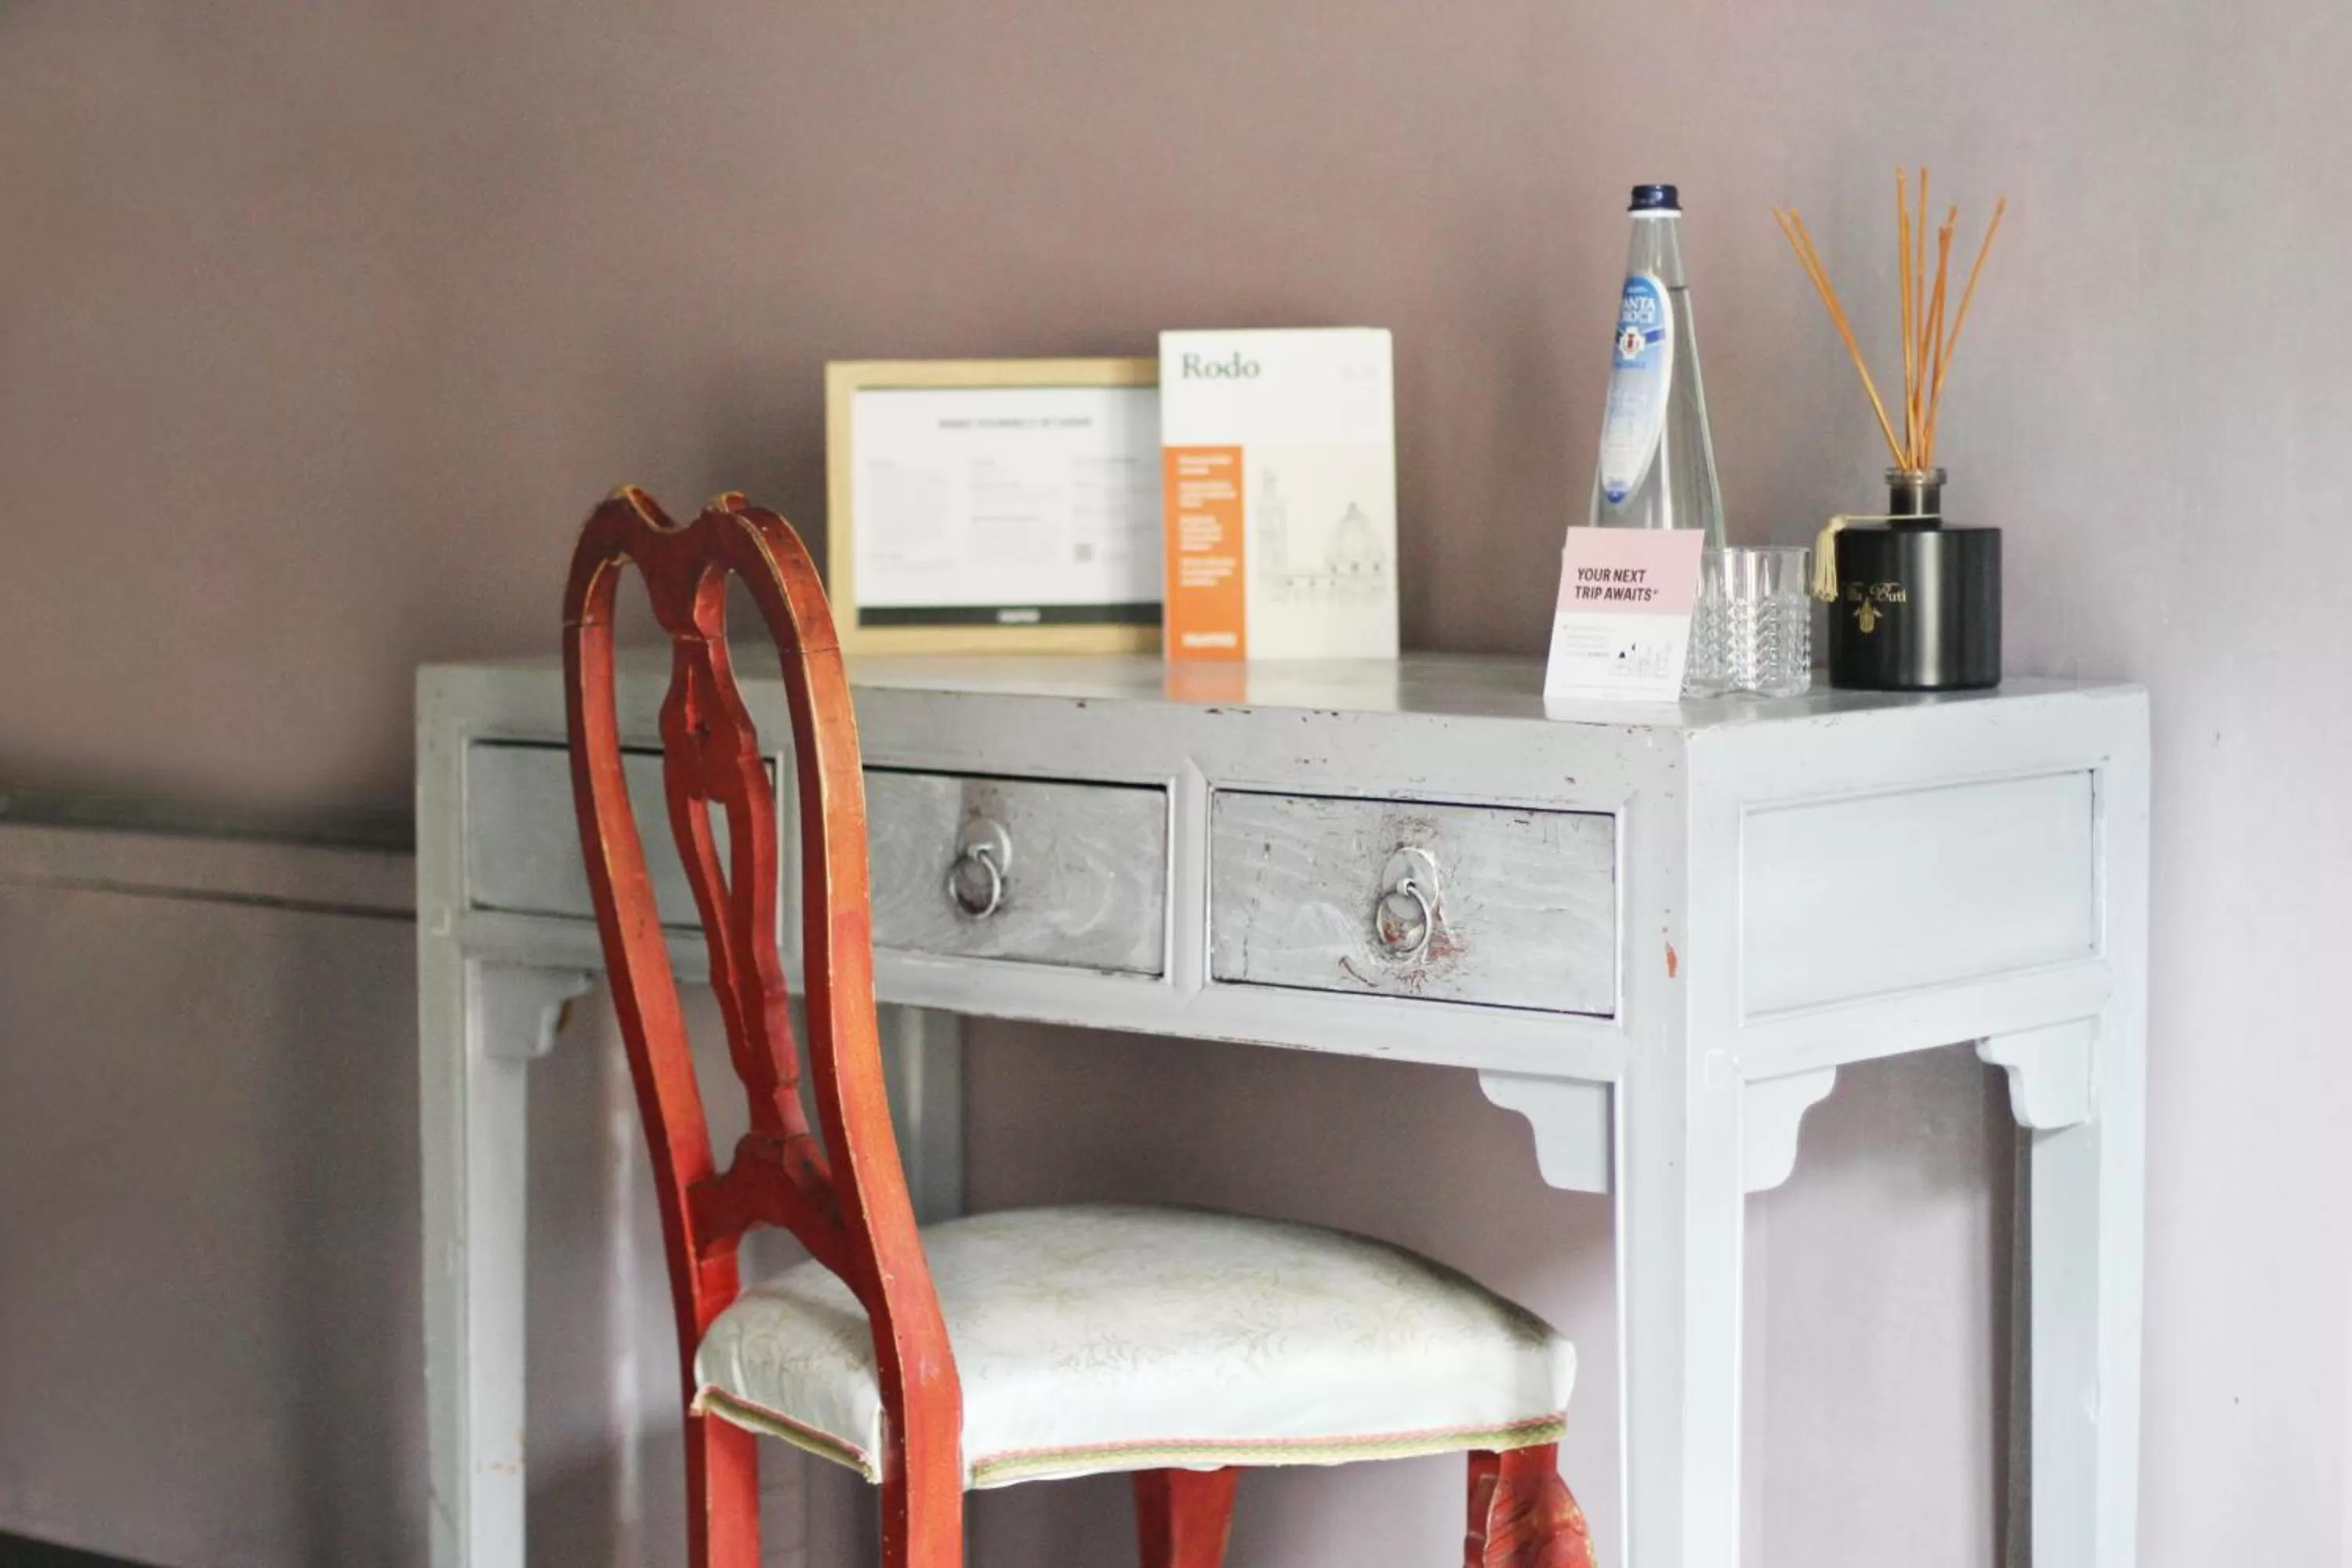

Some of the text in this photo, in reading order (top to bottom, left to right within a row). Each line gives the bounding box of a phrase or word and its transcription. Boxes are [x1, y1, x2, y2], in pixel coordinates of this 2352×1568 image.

[1621, 296, 1656, 312] ANTA
[1181, 351, 1261, 380] Rodo
[1577, 568, 1647, 583] YOUR NEXT
[1575, 586, 1602, 600] TRIP
